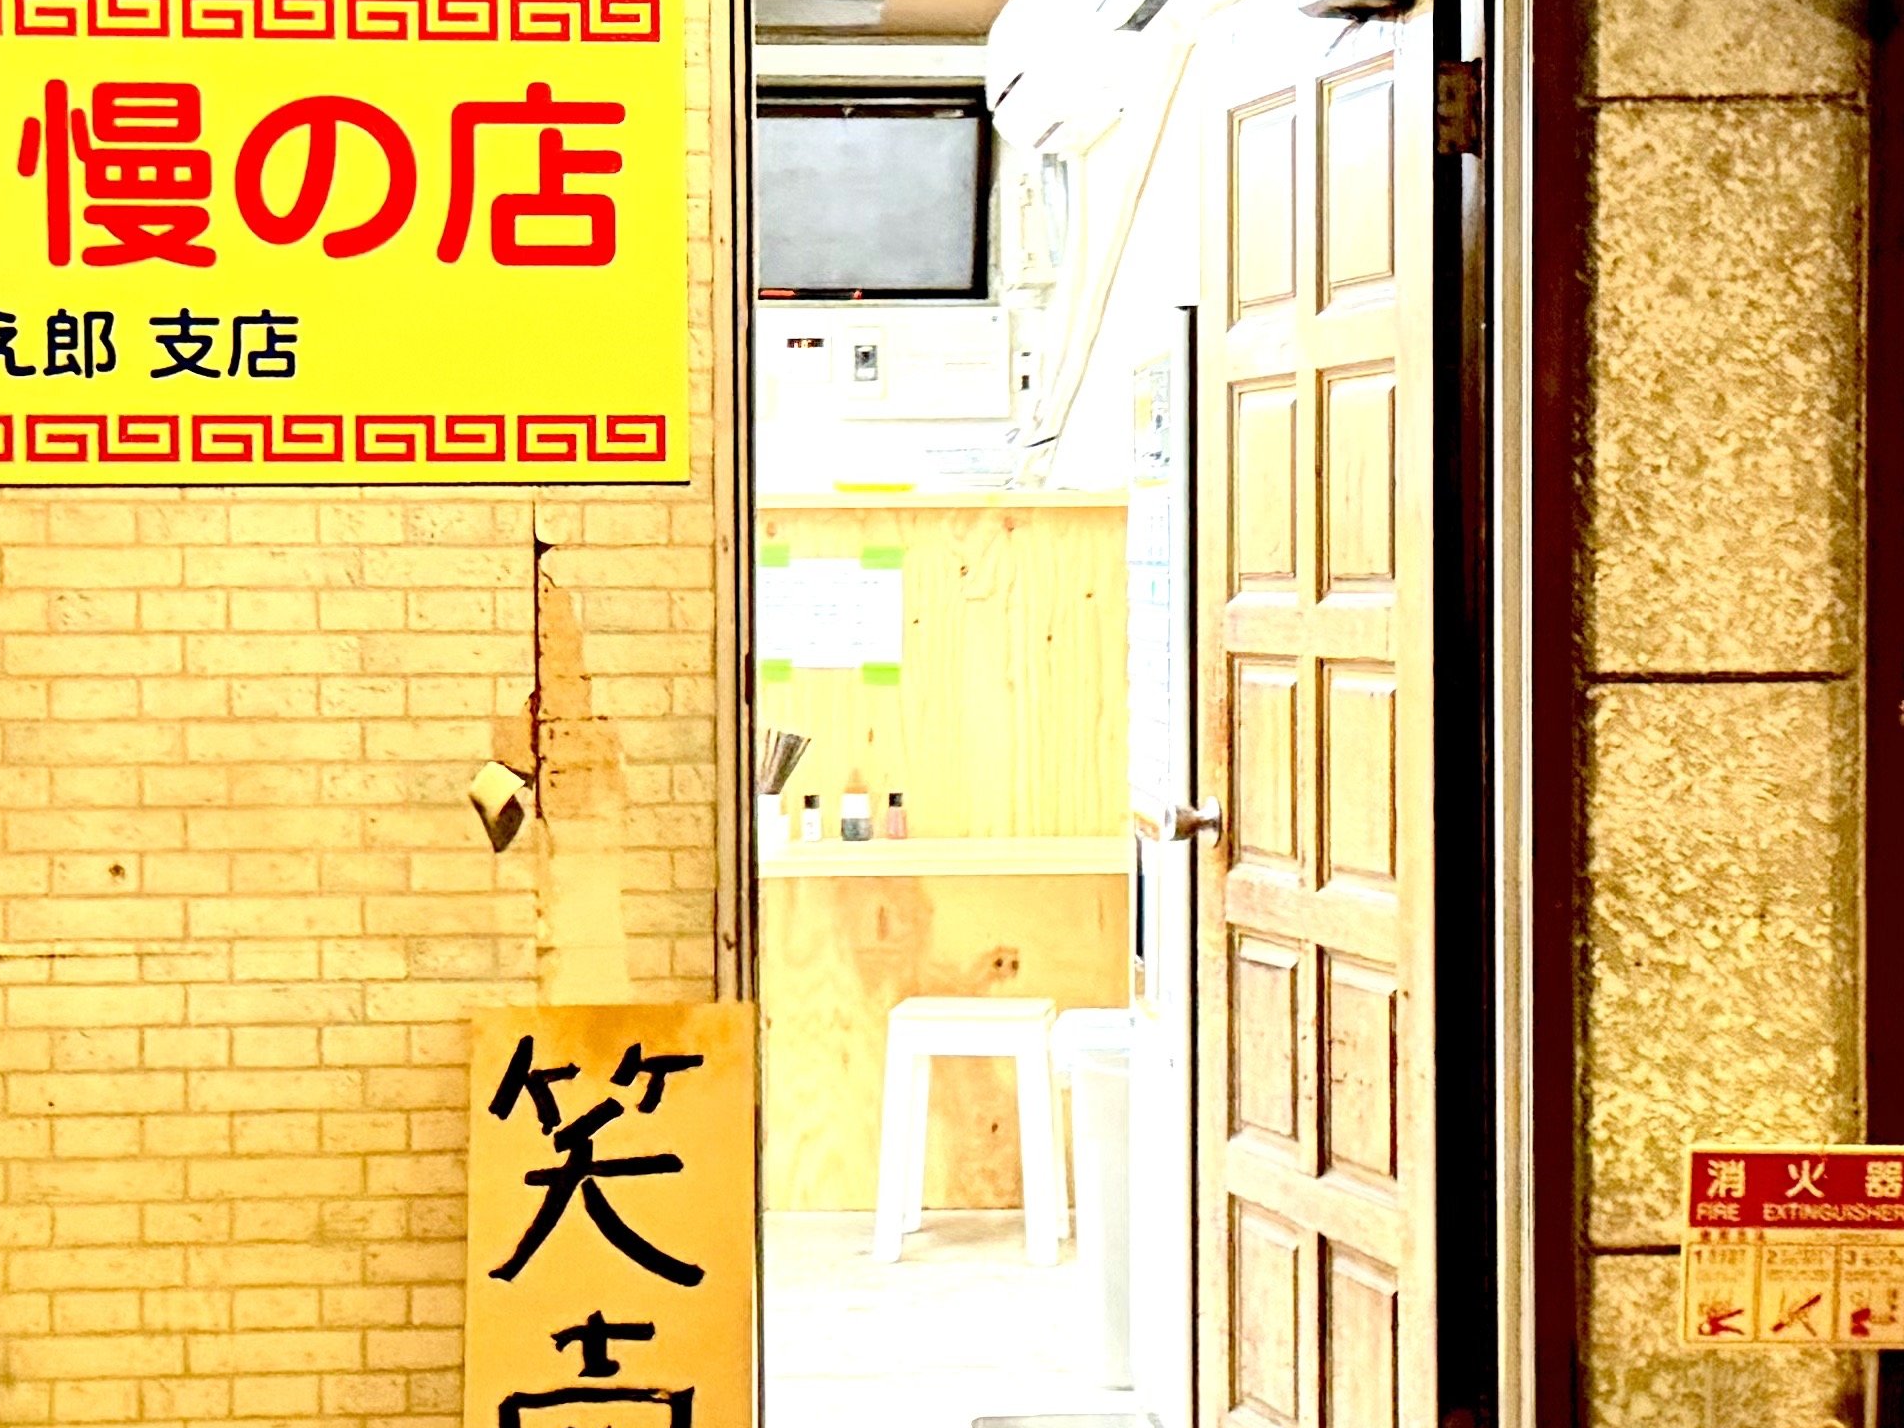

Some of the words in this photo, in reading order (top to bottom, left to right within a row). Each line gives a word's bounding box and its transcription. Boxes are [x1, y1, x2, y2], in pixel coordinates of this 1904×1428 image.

[148, 307, 301, 380] 支店
[1707, 1159, 1904, 1198] 消火器
[1696, 1202, 1741, 1223] FIRE
